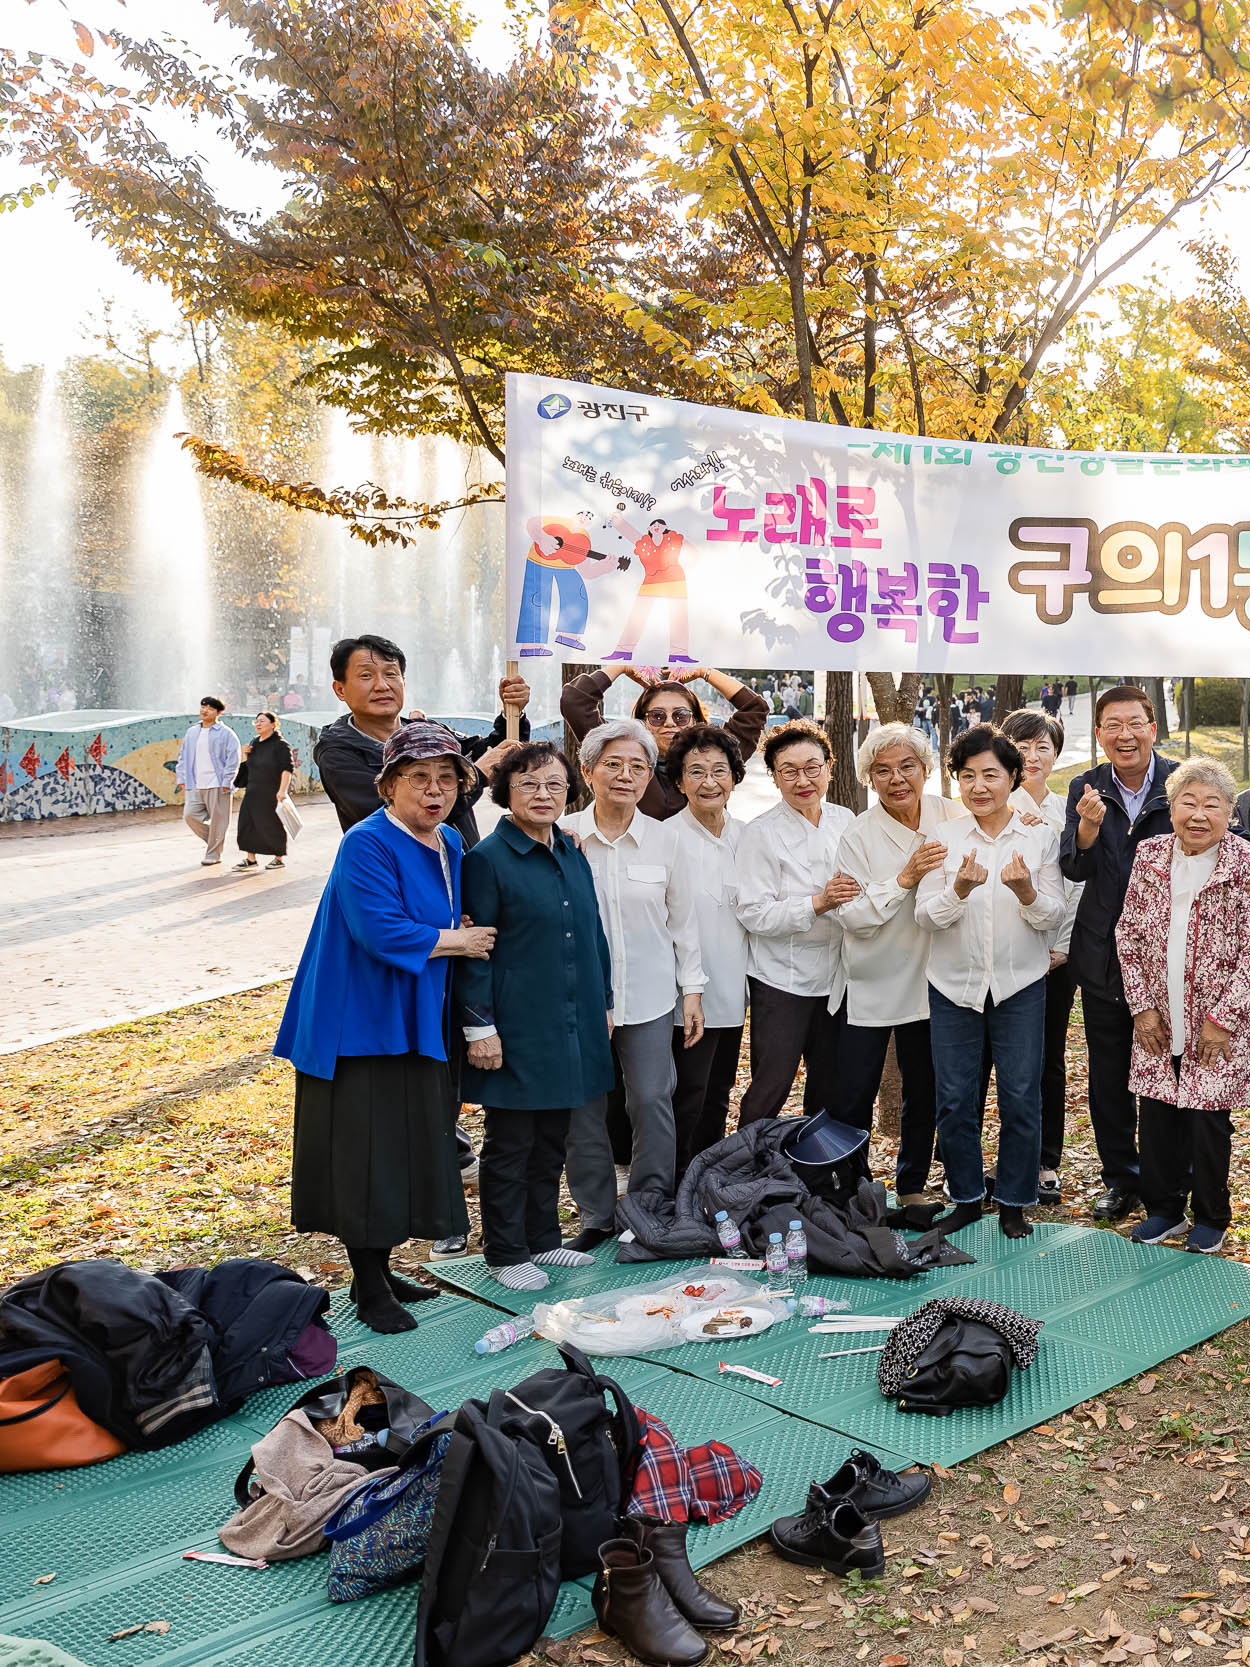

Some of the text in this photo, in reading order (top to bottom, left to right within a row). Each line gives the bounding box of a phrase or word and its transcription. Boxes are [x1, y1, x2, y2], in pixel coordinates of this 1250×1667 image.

[577, 400, 649, 422] 광진구
[562, 455, 598, 483] 노래는
[671, 450, 726, 492] 어서와!!
[706, 477, 883, 550] 노래로
[804, 558, 990, 644] 행복한
